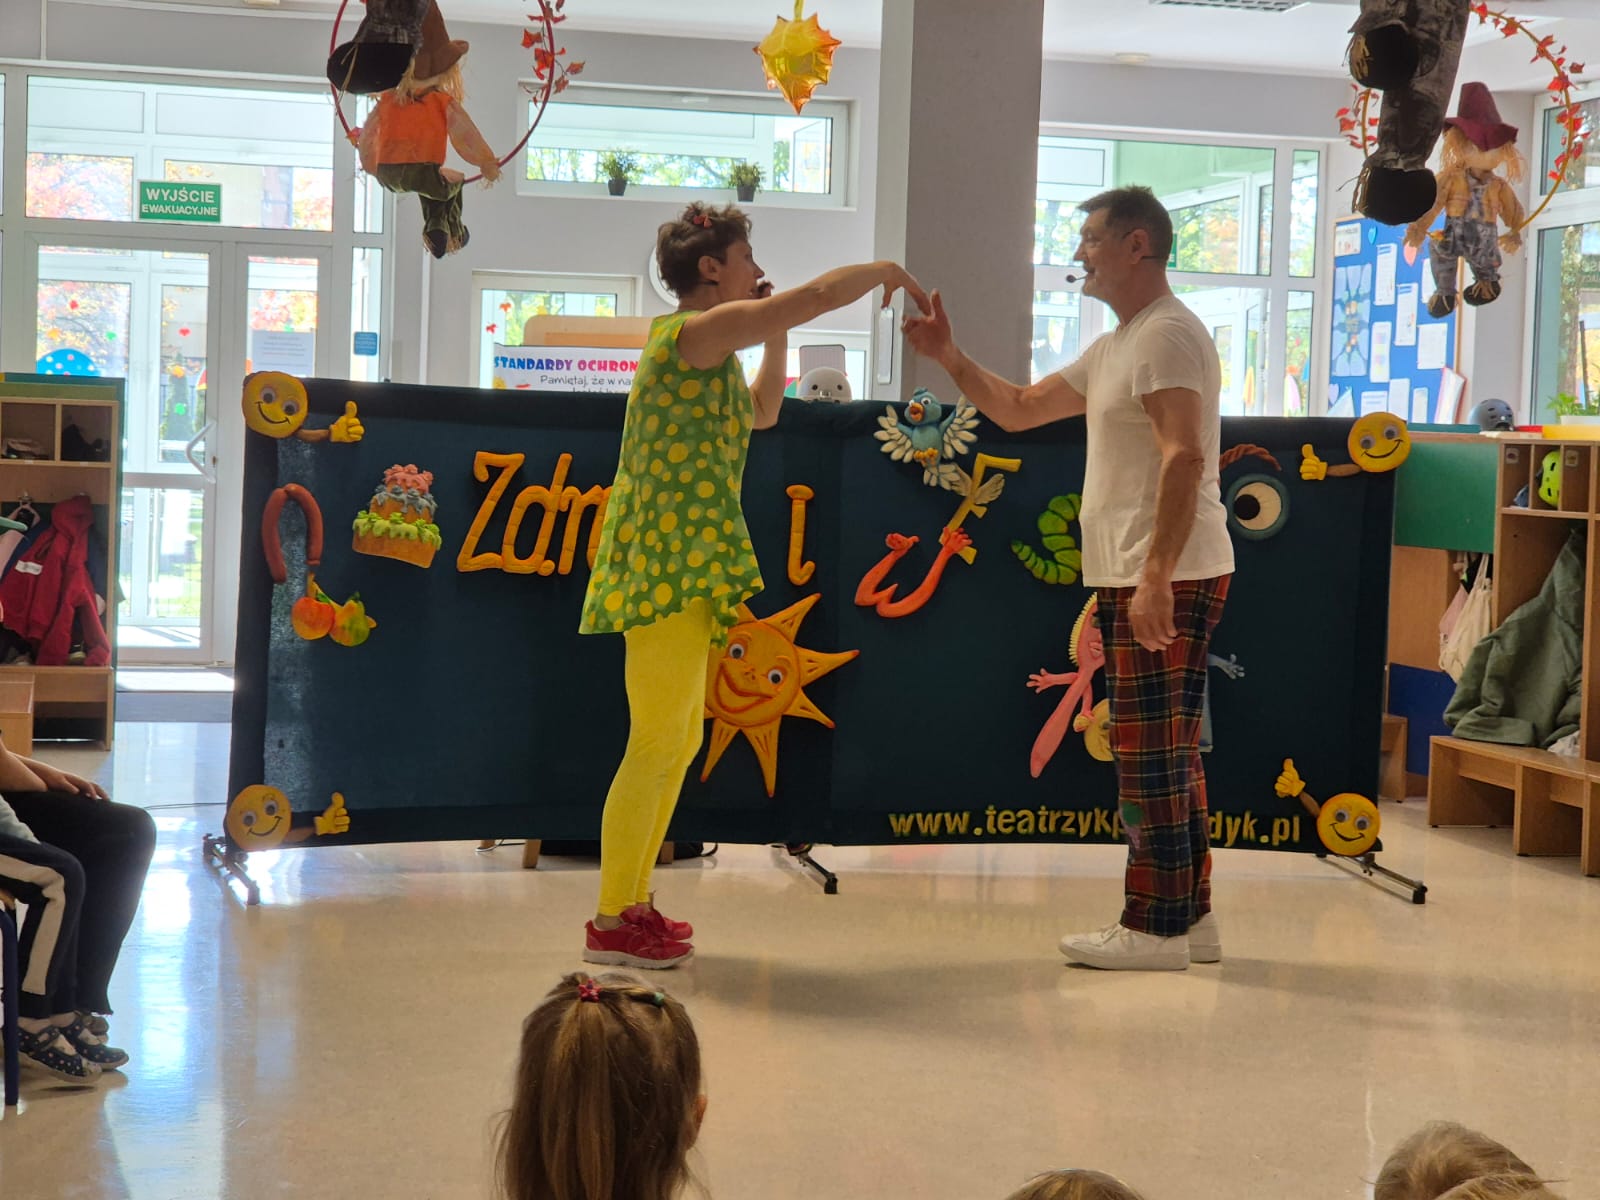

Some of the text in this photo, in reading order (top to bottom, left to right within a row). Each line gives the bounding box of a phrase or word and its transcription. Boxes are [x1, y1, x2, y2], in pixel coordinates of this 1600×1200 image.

[146, 186, 215, 204] WYJŚCIE
[141, 203, 218, 216] EWAKUACYJNE
[577, 359, 639, 373] OCHRON
[591, 374, 605, 386] że
[607, 377, 616, 386] w
[618, 377, 633, 386] na
[456, 451, 613, 576] Zdr
